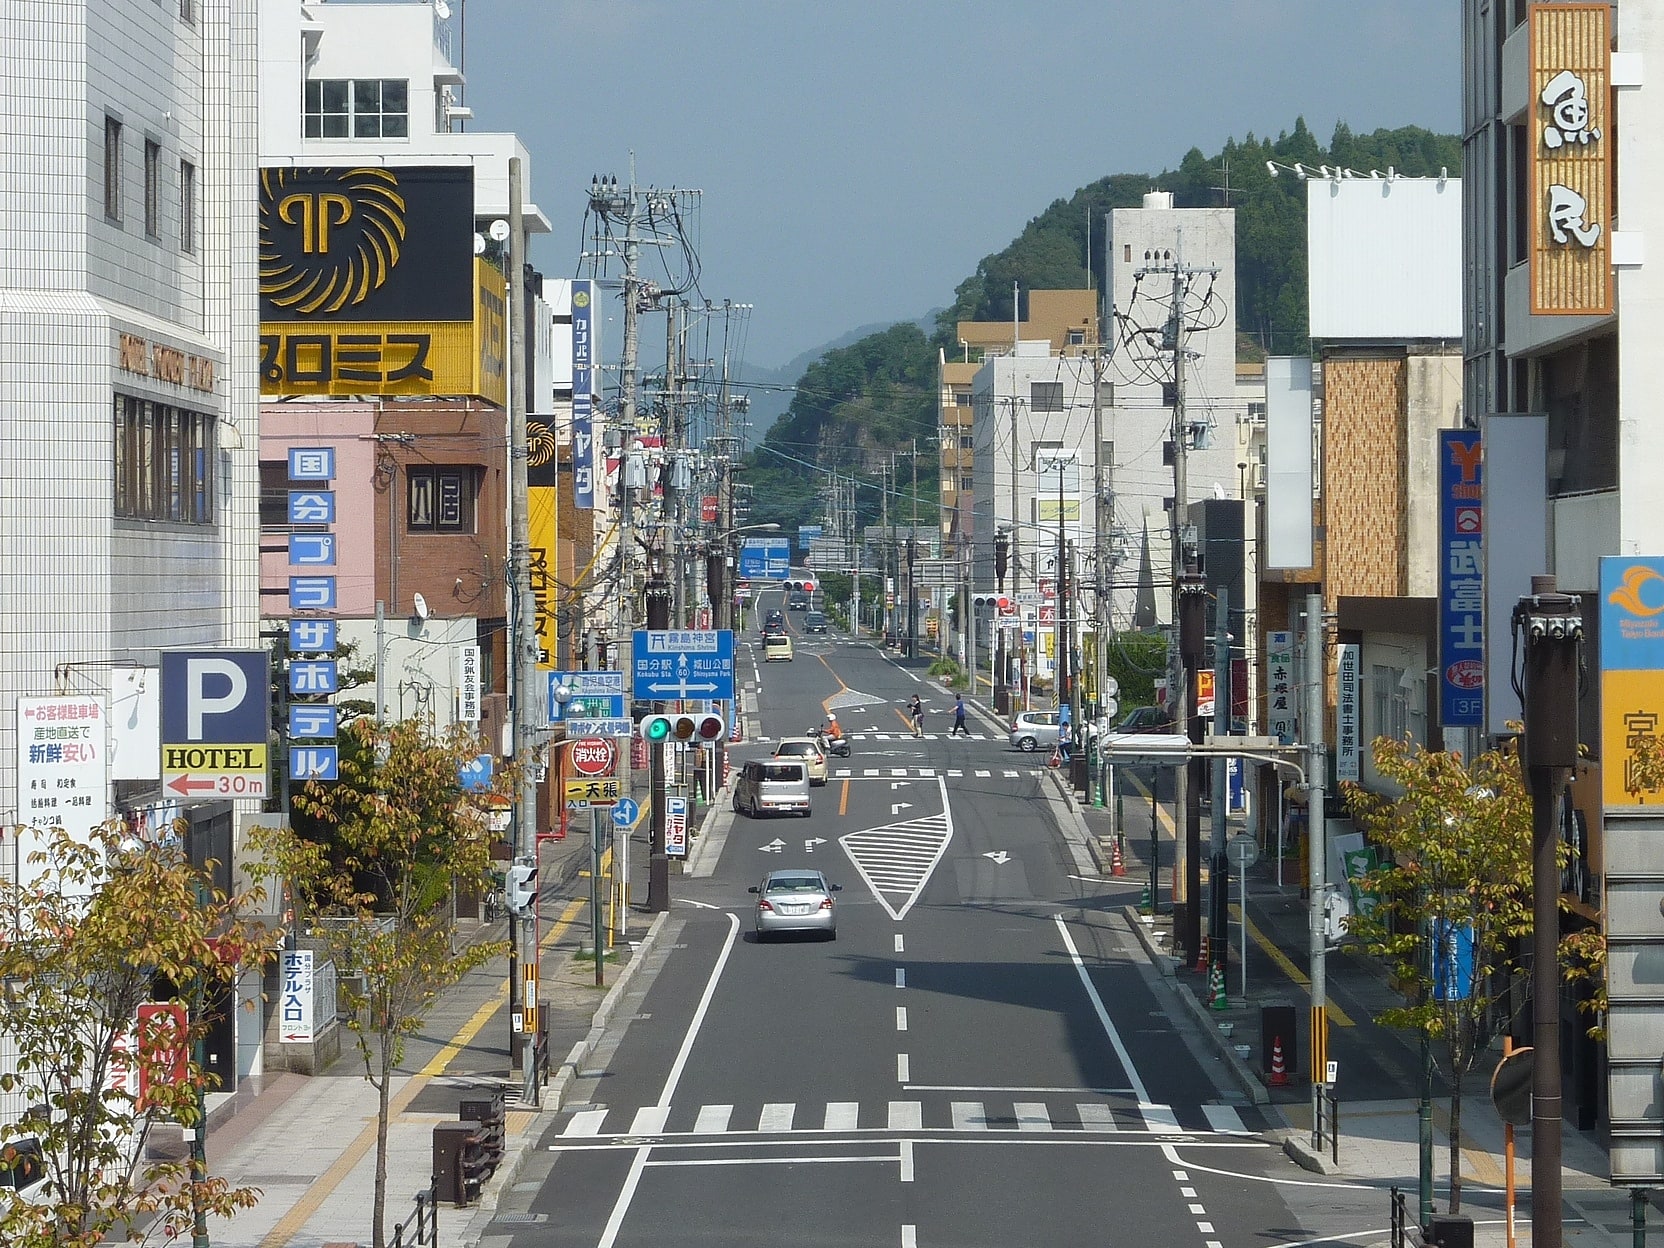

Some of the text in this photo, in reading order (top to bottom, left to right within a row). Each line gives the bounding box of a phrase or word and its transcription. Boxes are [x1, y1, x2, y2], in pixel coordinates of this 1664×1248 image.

[293, 450, 332, 777] 国分プラザホテル
[637, 659, 672, 671] 国分駅
[678, 669, 687, 677] 60
[1273, 666, 1289, 710] 赤塚屋
[187, 658, 248, 740] P
[1342, 651, 1354, 757] 加世田司法書士事務所
[36, 703, 99, 721] お客様駐車場
[33, 725, 91, 741] 産地直送で
[166, 748, 262, 769] HOTEL
[576, 747, 608, 763] 消火栓
[568, 782, 618, 798] 一天張
[568, 800, 588, 808] 入口
[668, 799, 685, 814] P
[284, 953, 303, 1022] ホテル入口
